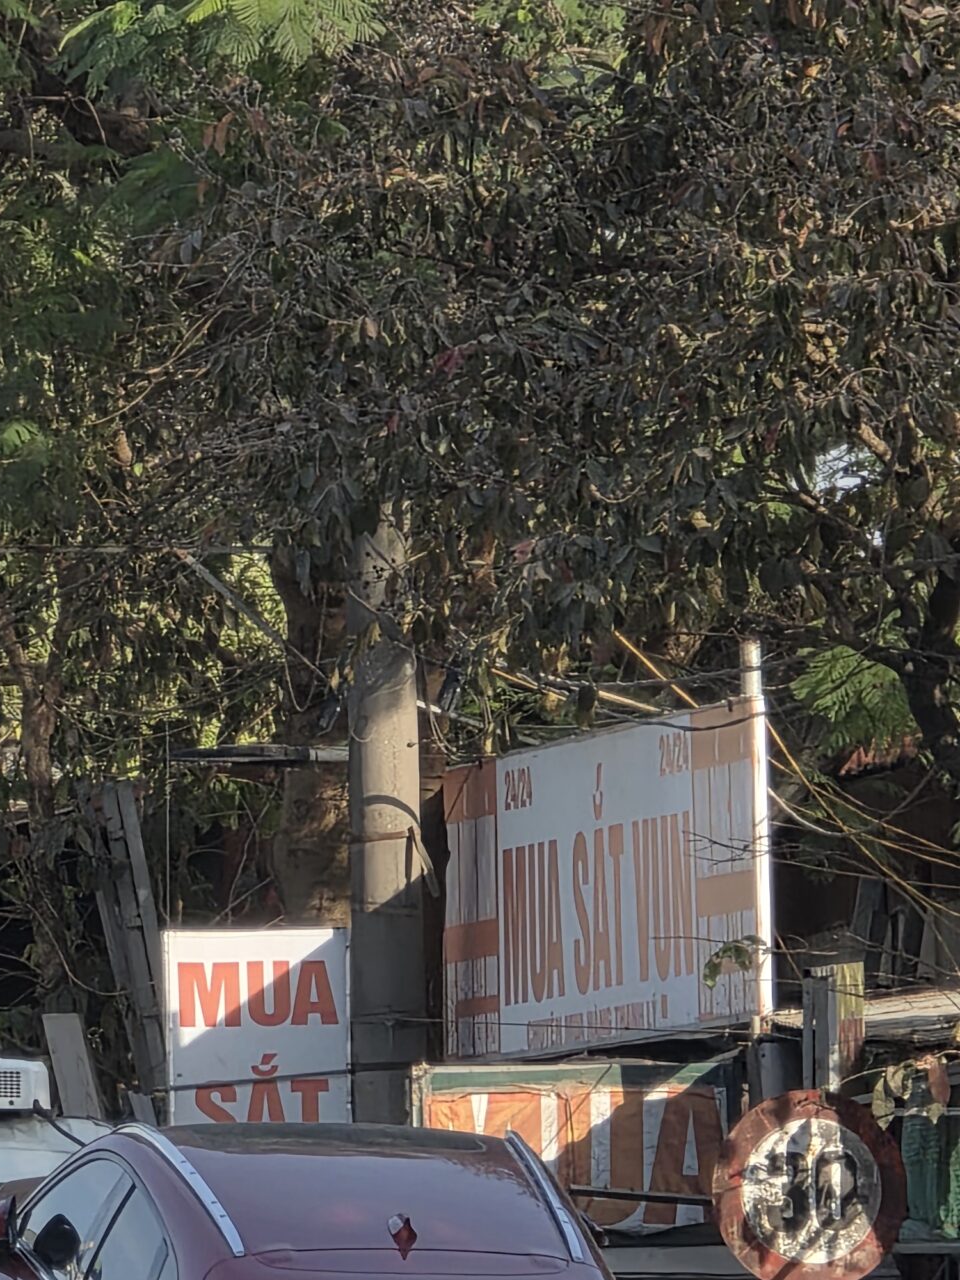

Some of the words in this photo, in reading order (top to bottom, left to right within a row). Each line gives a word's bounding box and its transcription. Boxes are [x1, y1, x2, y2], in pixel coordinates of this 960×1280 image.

[503, 766, 533, 812] 24/24
[502, 839, 566, 1007] MUA
[572, 762, 625, 996] SẮT
[632, 810, 695, 1019] VỤN
[177, 960, 339, 1028] MUA
[194, 1052, 330, 1124] SẮT
